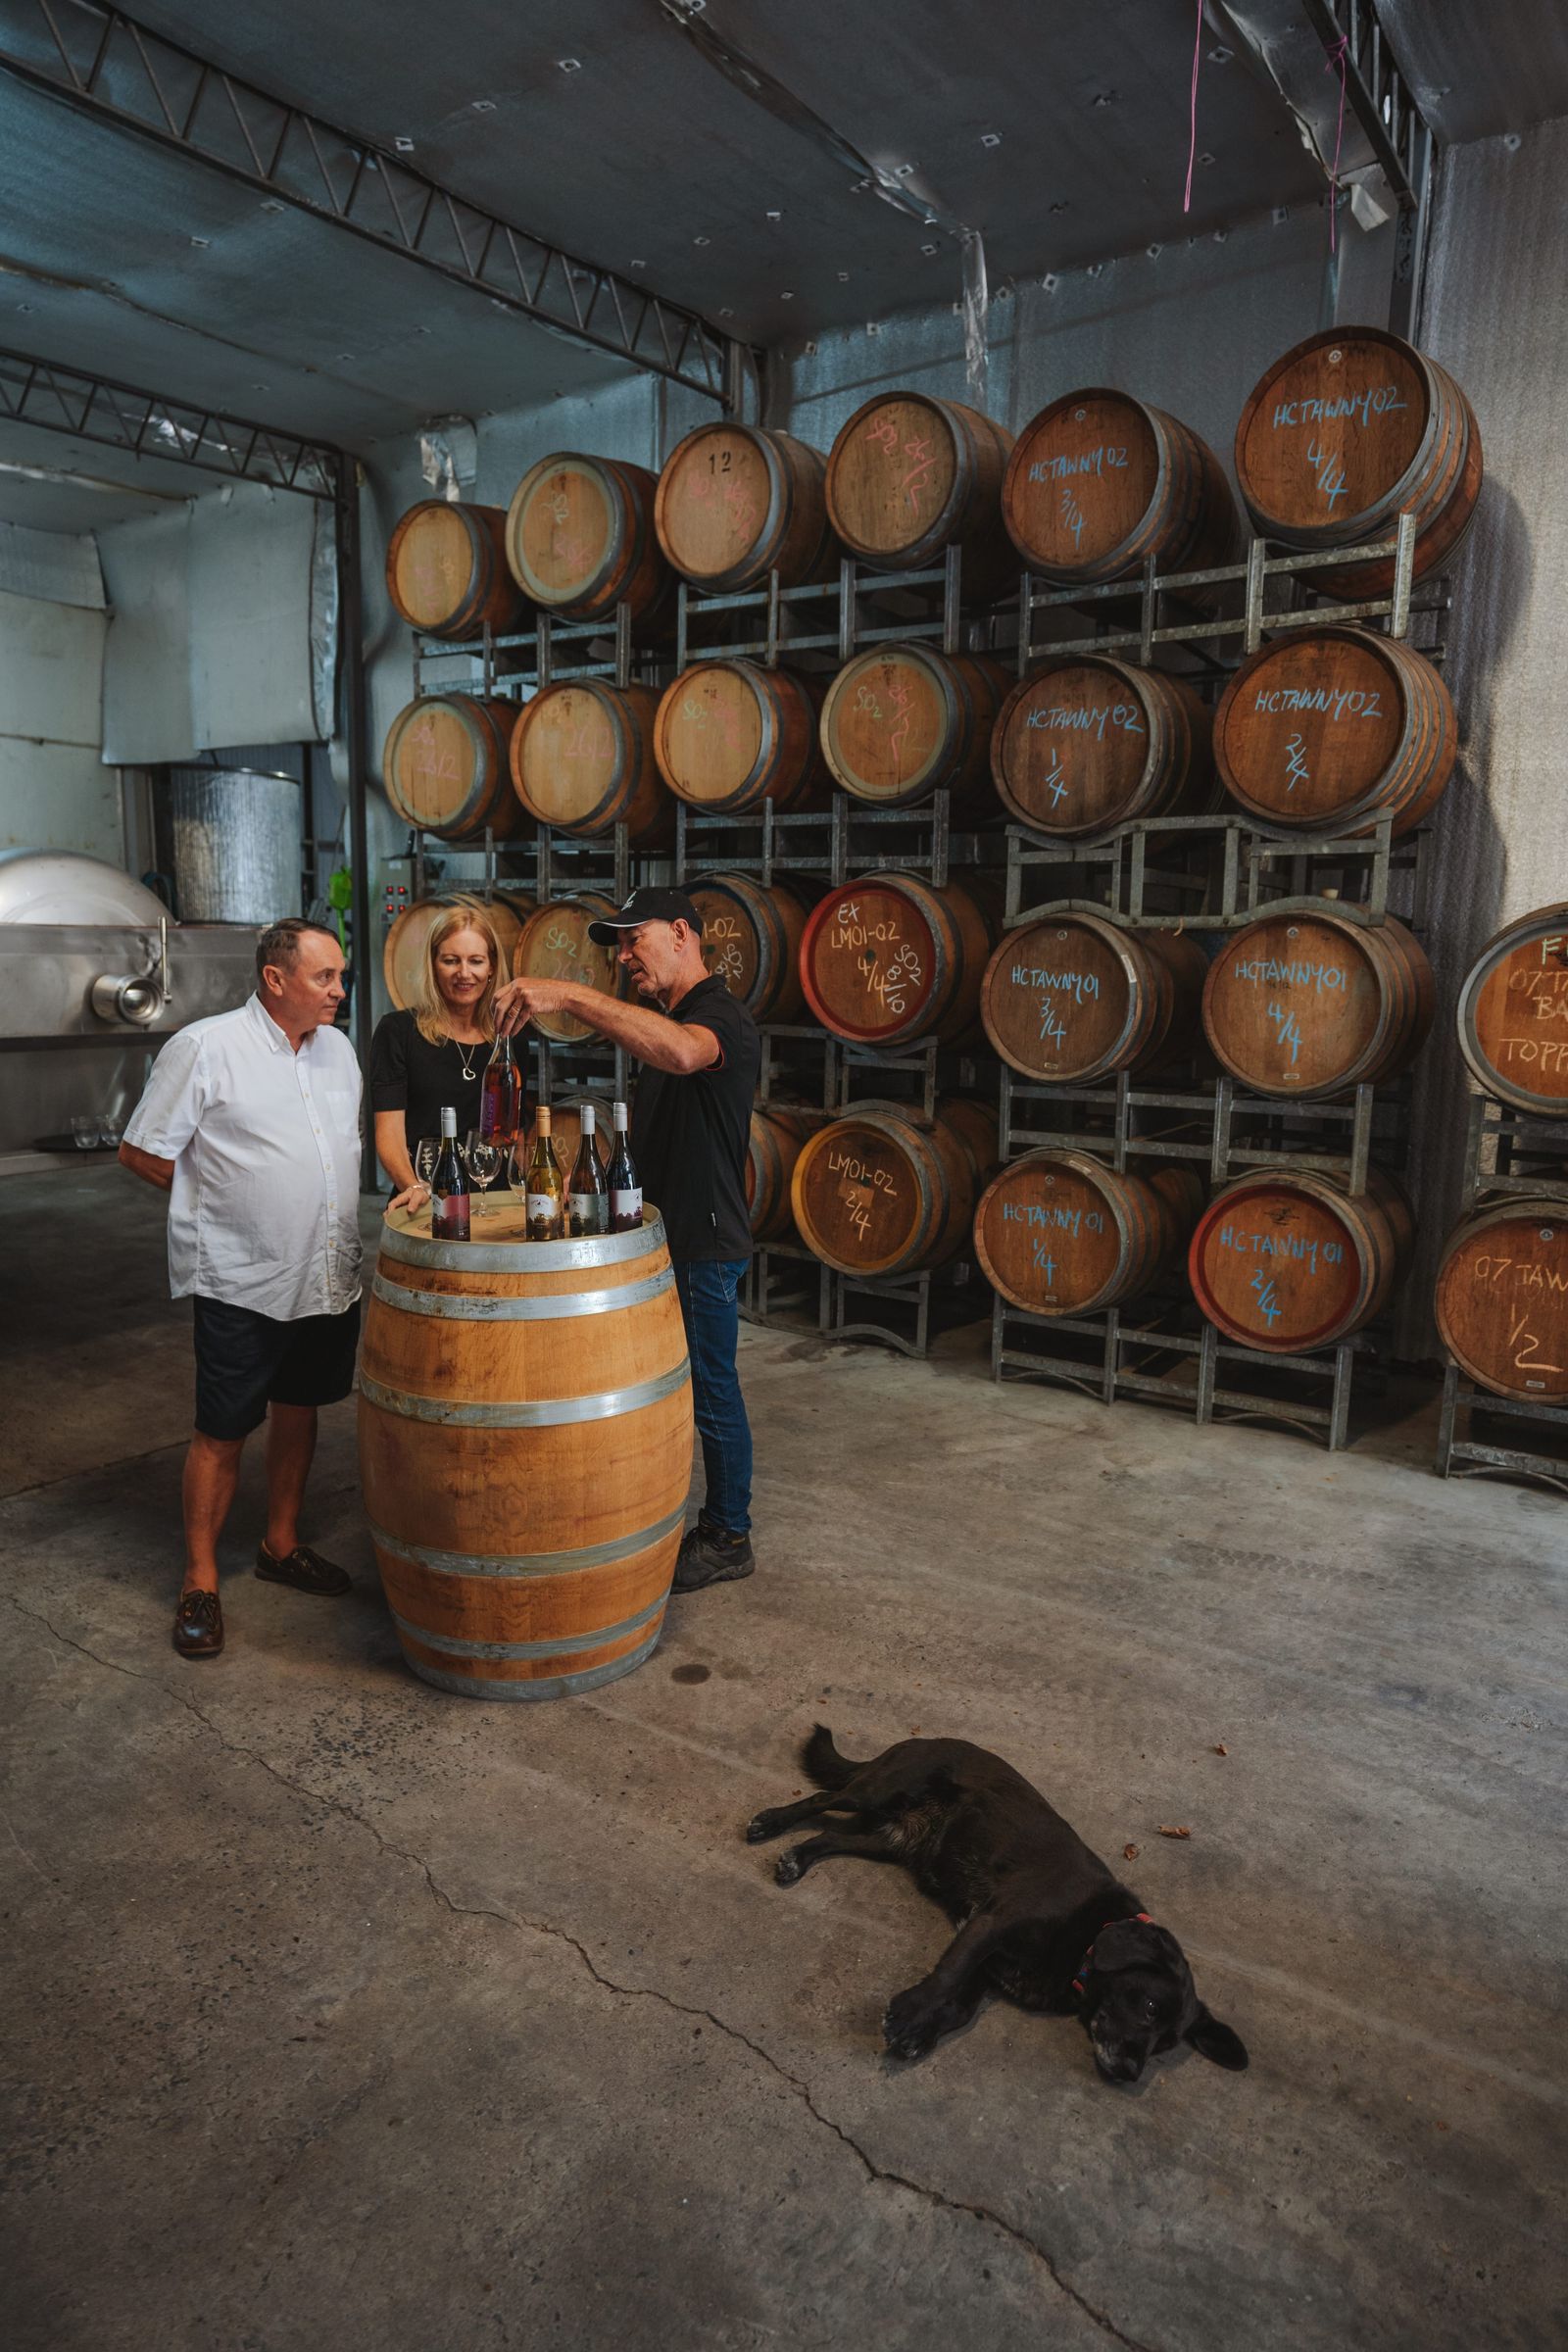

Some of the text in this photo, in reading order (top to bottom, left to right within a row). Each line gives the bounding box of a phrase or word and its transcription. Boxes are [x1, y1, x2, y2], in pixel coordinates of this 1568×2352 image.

[709, 451, 732, 475] 12
[1307, 439, 1348, 512] 4/4
[853, 685, 883, 719] SO2
[703, 917, 742, 938] 1-02
[837, 903, 860, 924] EX
[545, 925, 577, 957] SO2
[894, 944, 921, 986] SO2
[1040, 996, 1066, 1051] 3/4
[1267, 1001, 1302, 1065] 4/4
[845, 1191, 871, 1242] 2/4
[1034, 1238, 1058, 1287] 1/4
[1250, 1269, 1282, 1328] 2/4
[1508, 1303, 1564, 1373] 1/2
